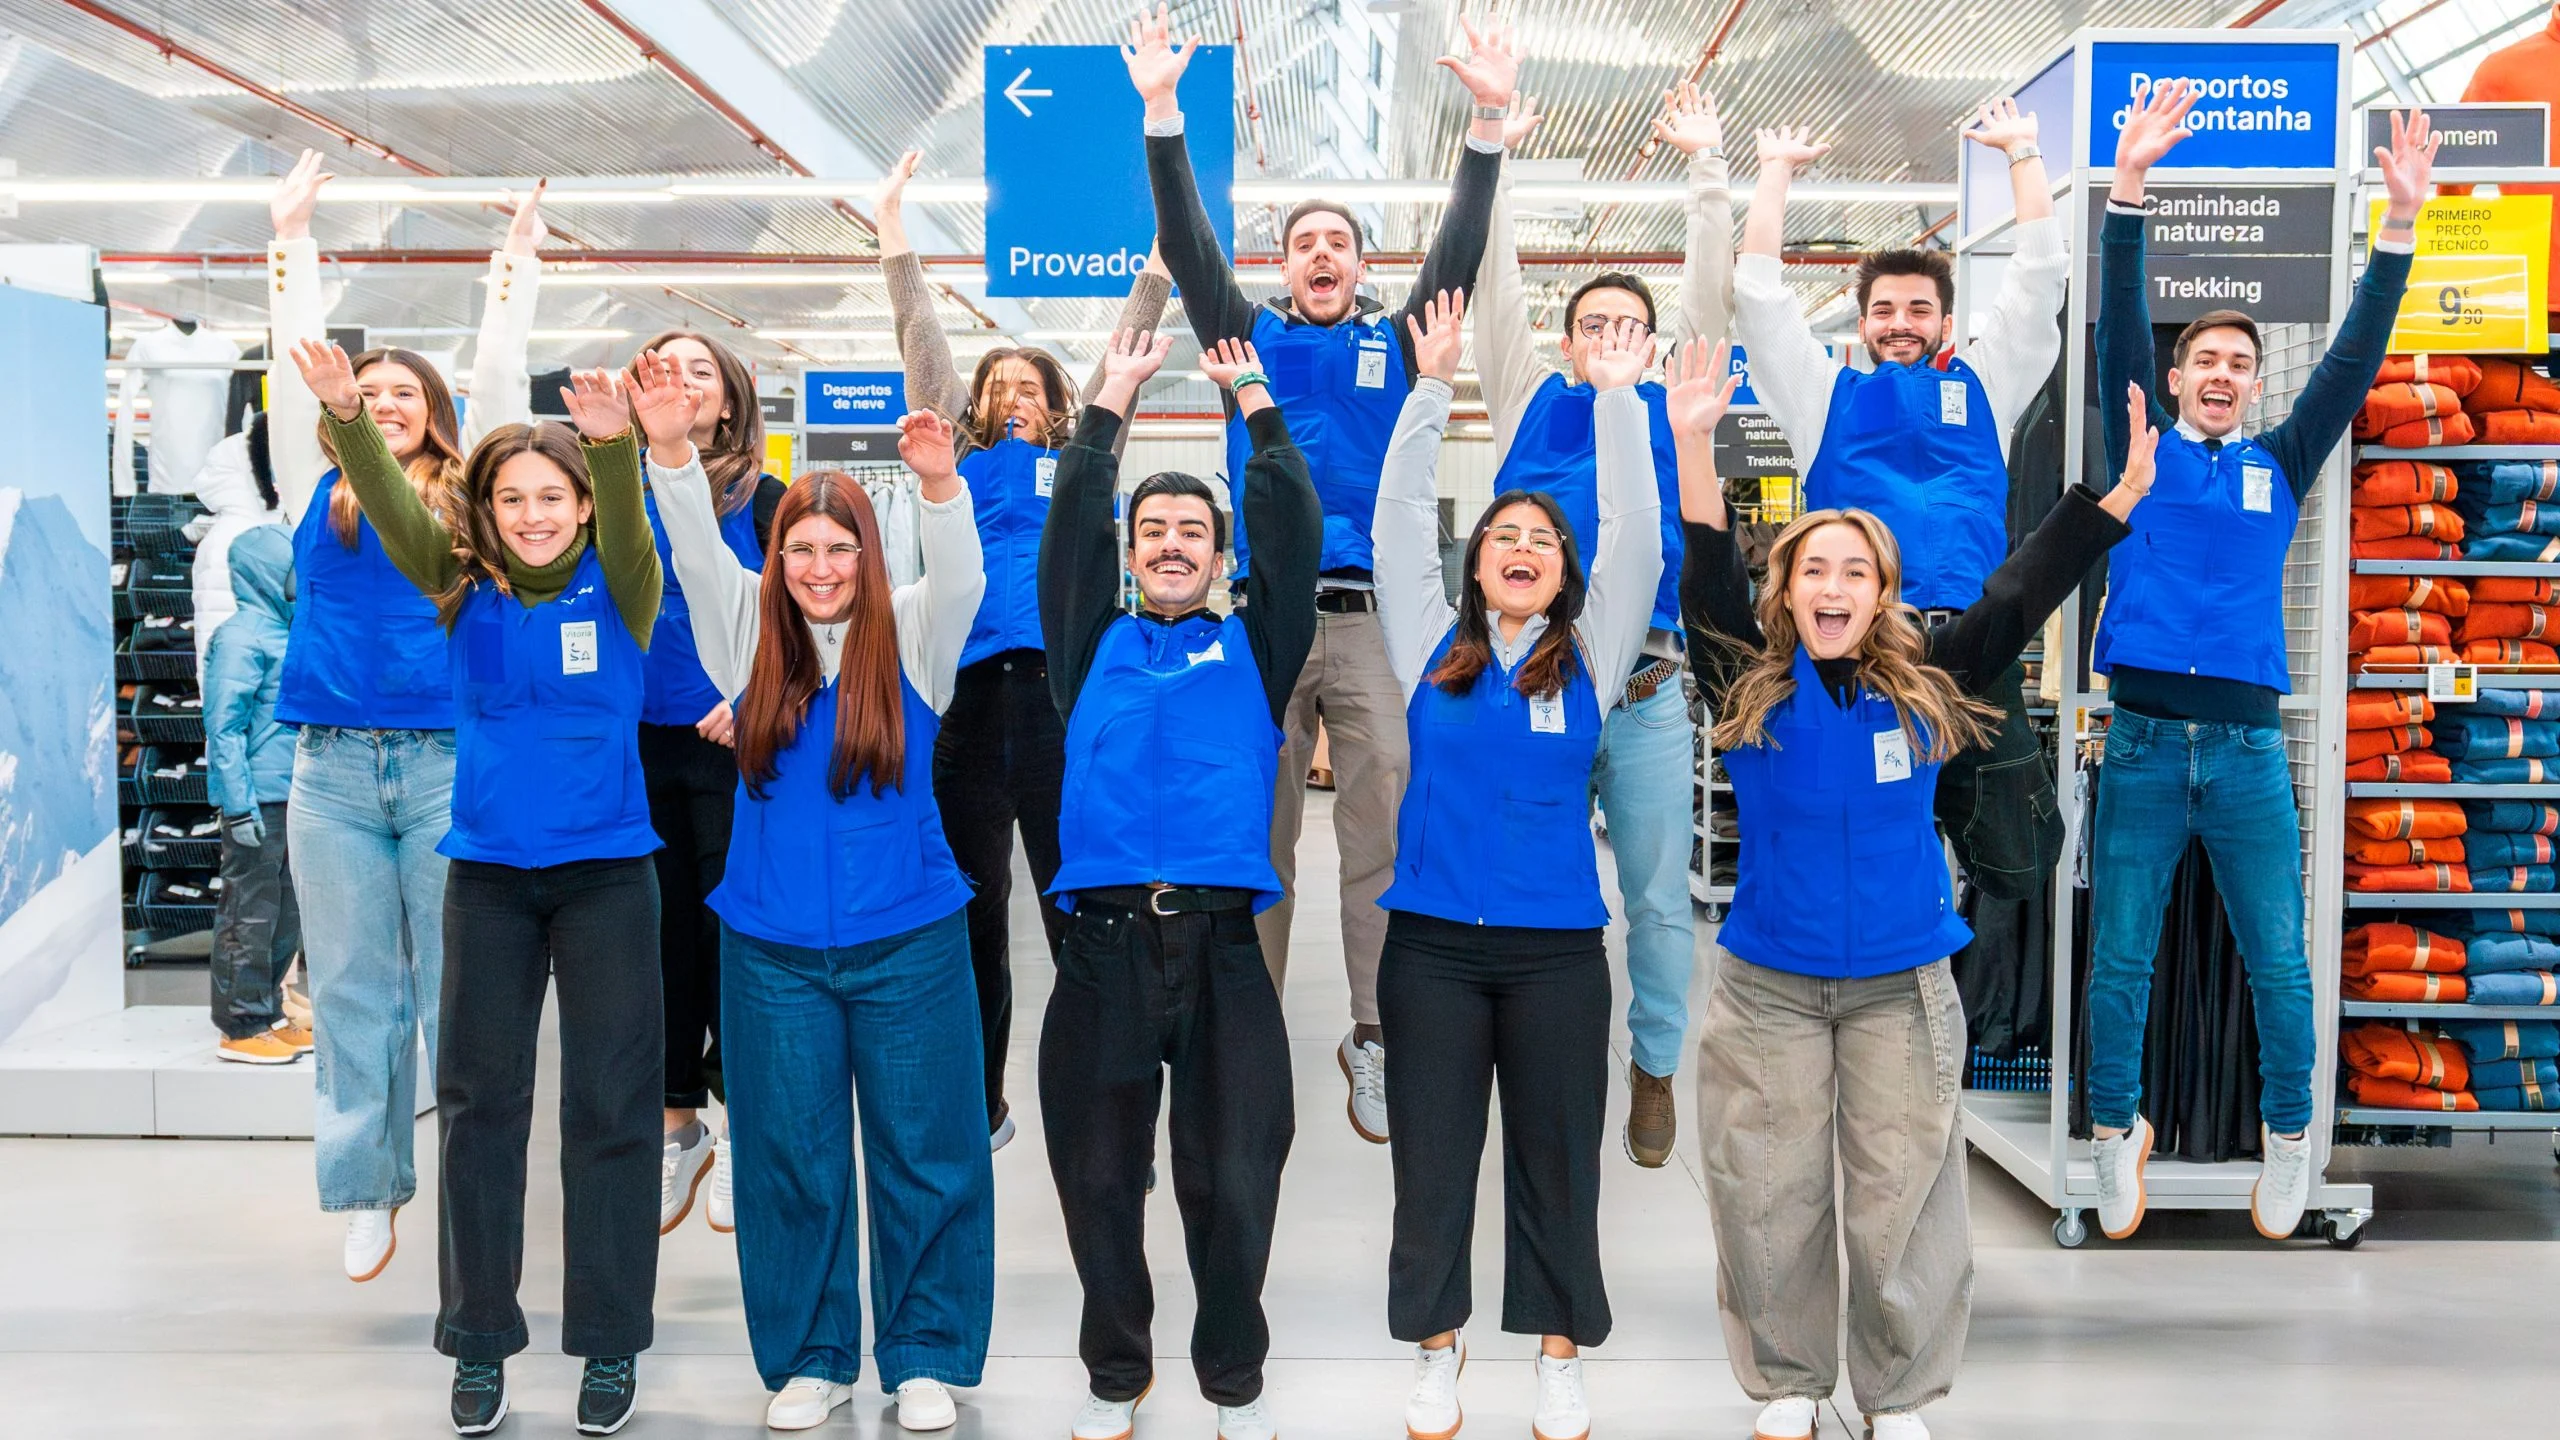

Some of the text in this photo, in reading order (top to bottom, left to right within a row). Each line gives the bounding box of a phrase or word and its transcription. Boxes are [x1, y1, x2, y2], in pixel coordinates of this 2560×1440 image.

[2175, 104, 2312, 131] ontanha
[2142, 193, 2281, 217] Caminhada
[2427, 209, 2492, 221] PRIMEIRO
[2154, 221, 2264, 243] natureza
[2436, 224, 2482, 238] PREÇO
[1010, 246, 1149, 277] Provado
[2154, 275, 2263, 304] Trekking
[822, 383, 893, 398] Desportos
[832, 397, 887, 410] de neve
[1738, 416, 1777, 428] Camin
[1745, 430, 1785, 440] nature
[851, 440, 868, 451] Ski
[1746, 455, 1797, 469] Trekking
